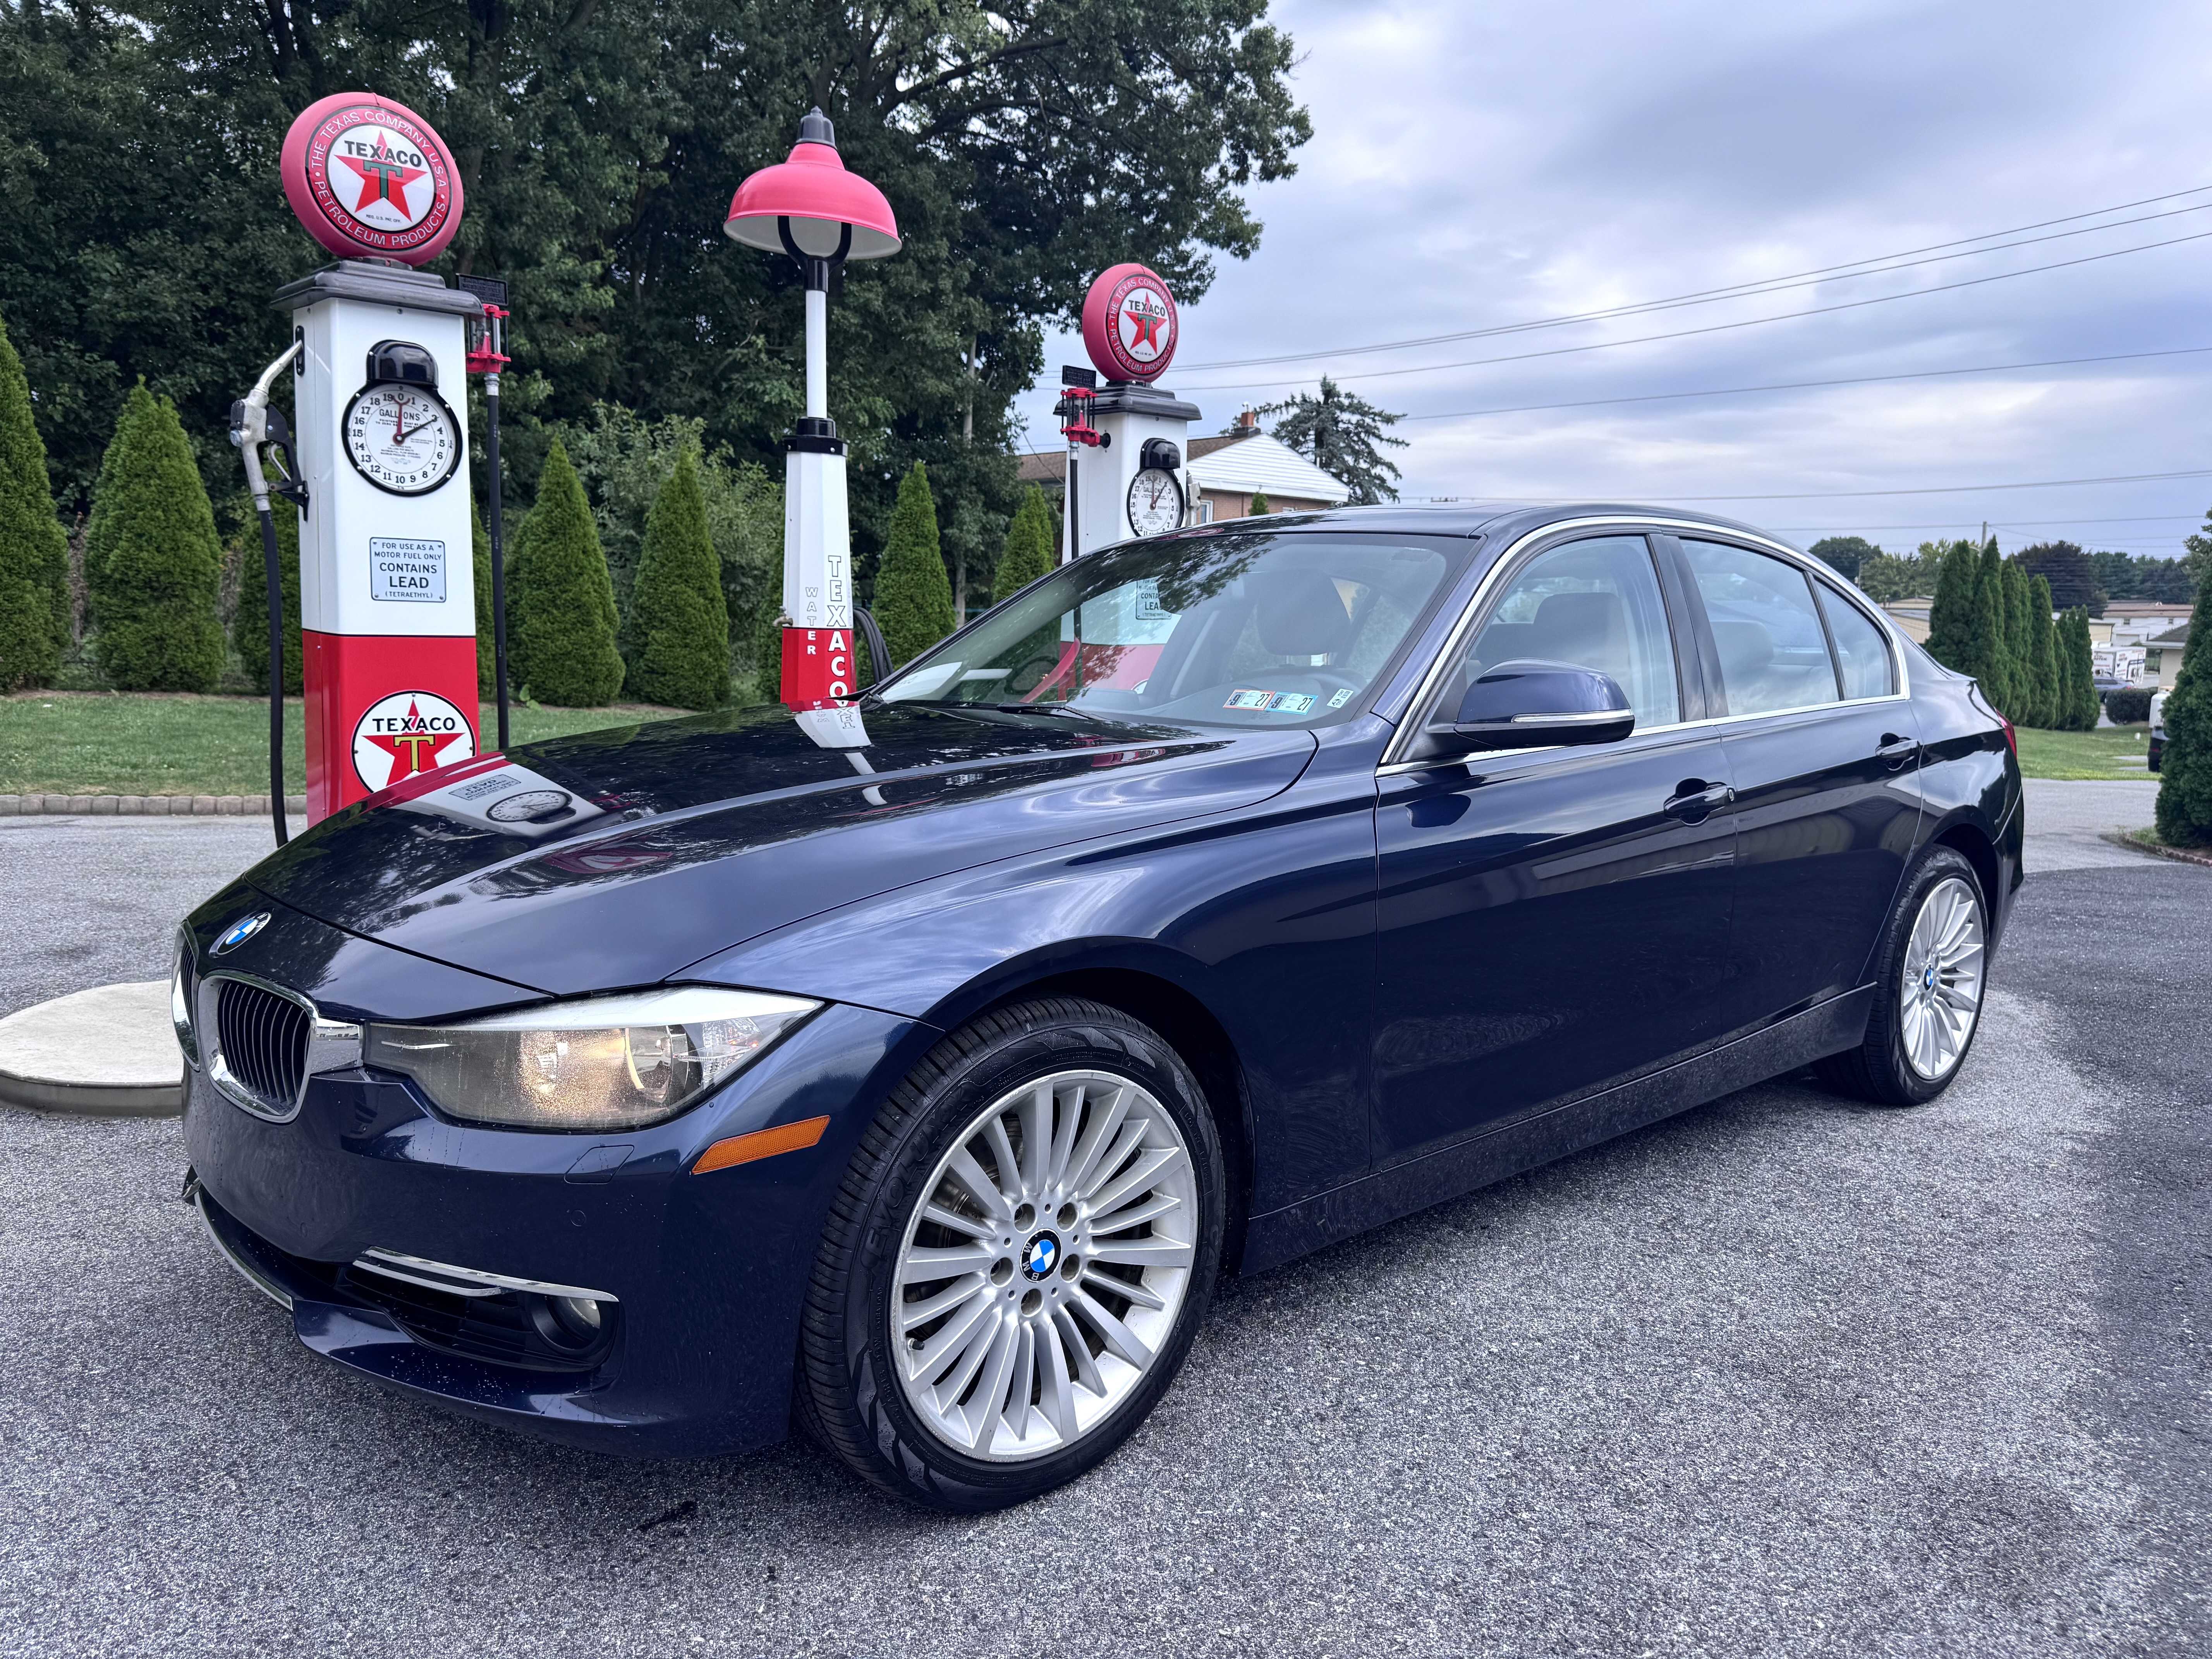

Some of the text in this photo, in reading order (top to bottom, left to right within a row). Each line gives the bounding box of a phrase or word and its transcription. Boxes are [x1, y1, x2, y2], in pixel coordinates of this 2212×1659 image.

[311, 141, 326, 169] THE
[320, 112, 360, 140] TEXAS
[365, 111, 430, 148] COMPANY
[344, 140, 422, 167] TEXACO
[363, 160, 403, 199] T
[314, 181, 446, 246] PETROLEUM PRODUCTS
[1109, 302, 1119, 319] THE
[1116, 279, 1137, 299] TEXAS
[1128, 300, 1165, 317] TEXACO
[1137, 313, 1157, 340] T
[1110, 329, 1142, 372] PETROLEUM
[380, 409, 420, 421] GALLONS
[380, 562, 437, 574] CONTAINS
[389, 576, 429, 588] LEAD
[1145, 602, 1159, 610] LEA
[805, 587, 818, 655] WATER
[827, 555, 848, 698] TEXACO
[1230, 694, 1270, 707] 9 27
[1271, 697, 1314, 711] 9 27
[372, 717, 455, 732] TEXACO
[393, 735, 436, 772] T
[1022, 1242, 1039, 1280] BMW
